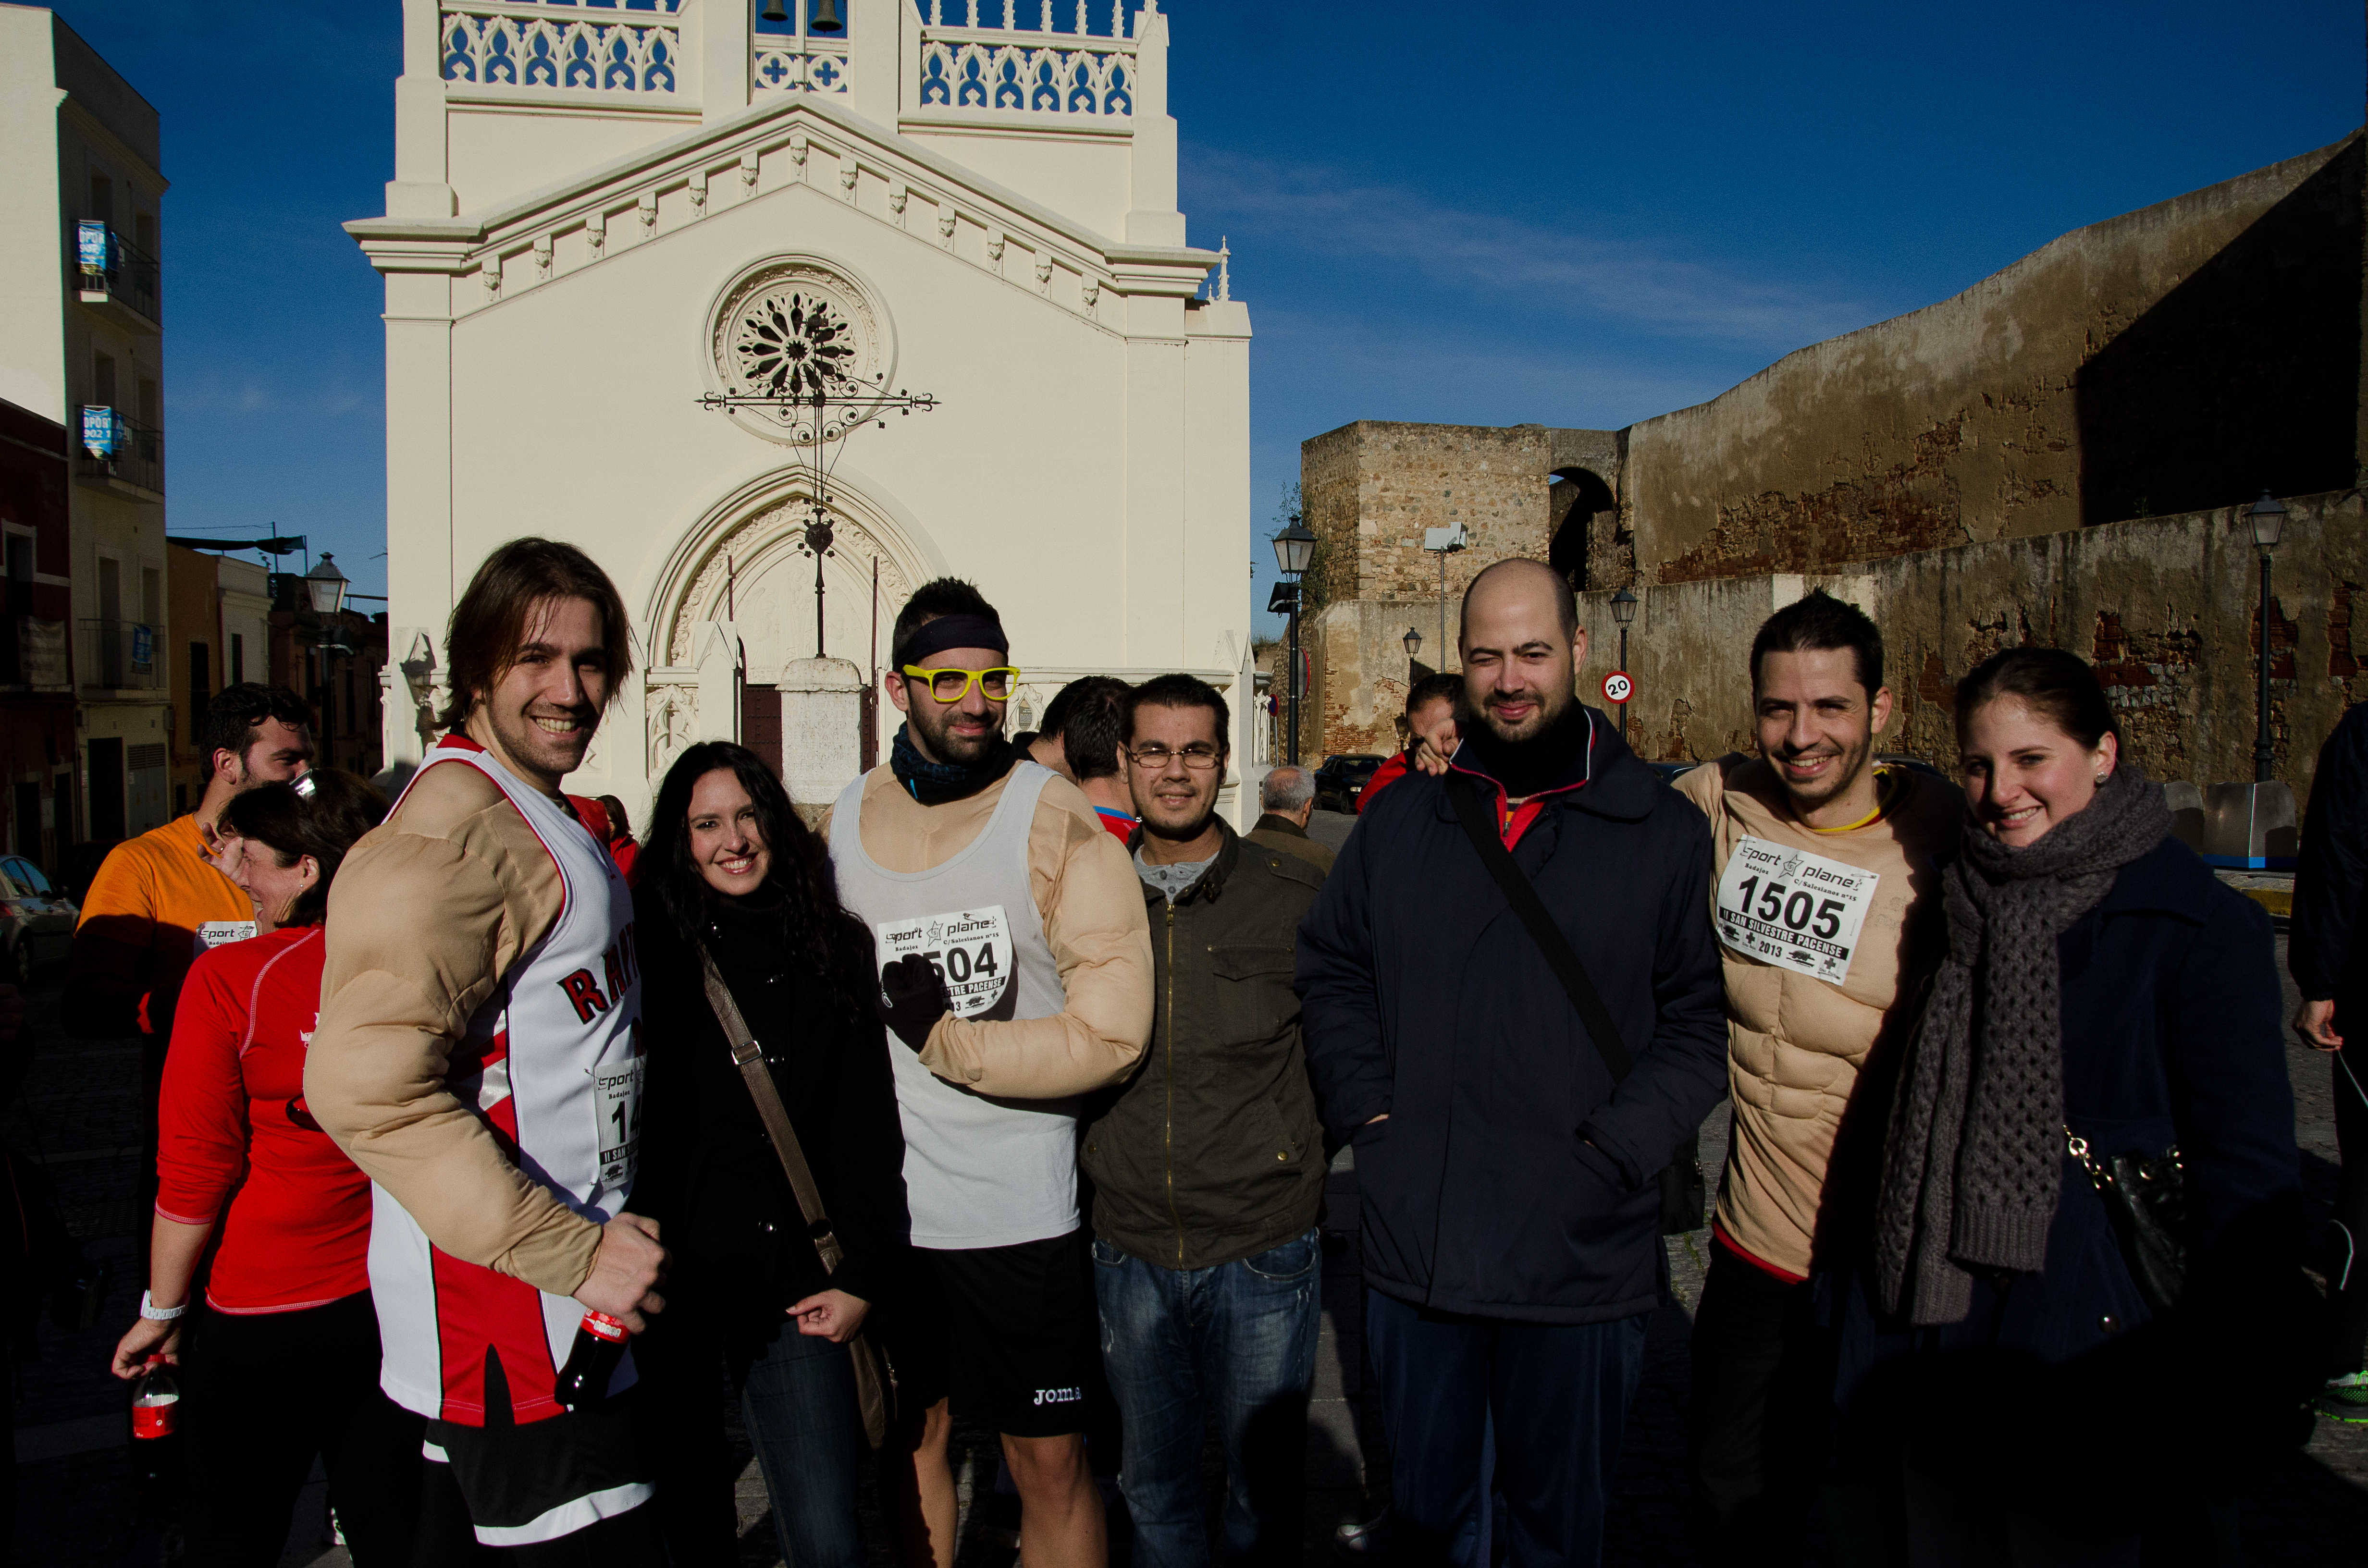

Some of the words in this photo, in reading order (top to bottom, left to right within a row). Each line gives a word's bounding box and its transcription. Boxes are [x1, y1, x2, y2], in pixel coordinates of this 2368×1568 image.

[85, 429, 103, 438] 902
[1608, 680, 1628, 696] 20
[1745, 863, 1769, 874] Badajoz
[1739, 875, 1846, 939] 1505
[1730, 912, 1747, 927] SAN
[1748, 917, 1794, 943] SILVESTRE
[1797, 931, 1842, 957] PACENSE
[1759, 941, 1782, 958] 2013
[968, 978, 1002, 993] PACENSE
[613, 1146, 626, 1161] SAN
